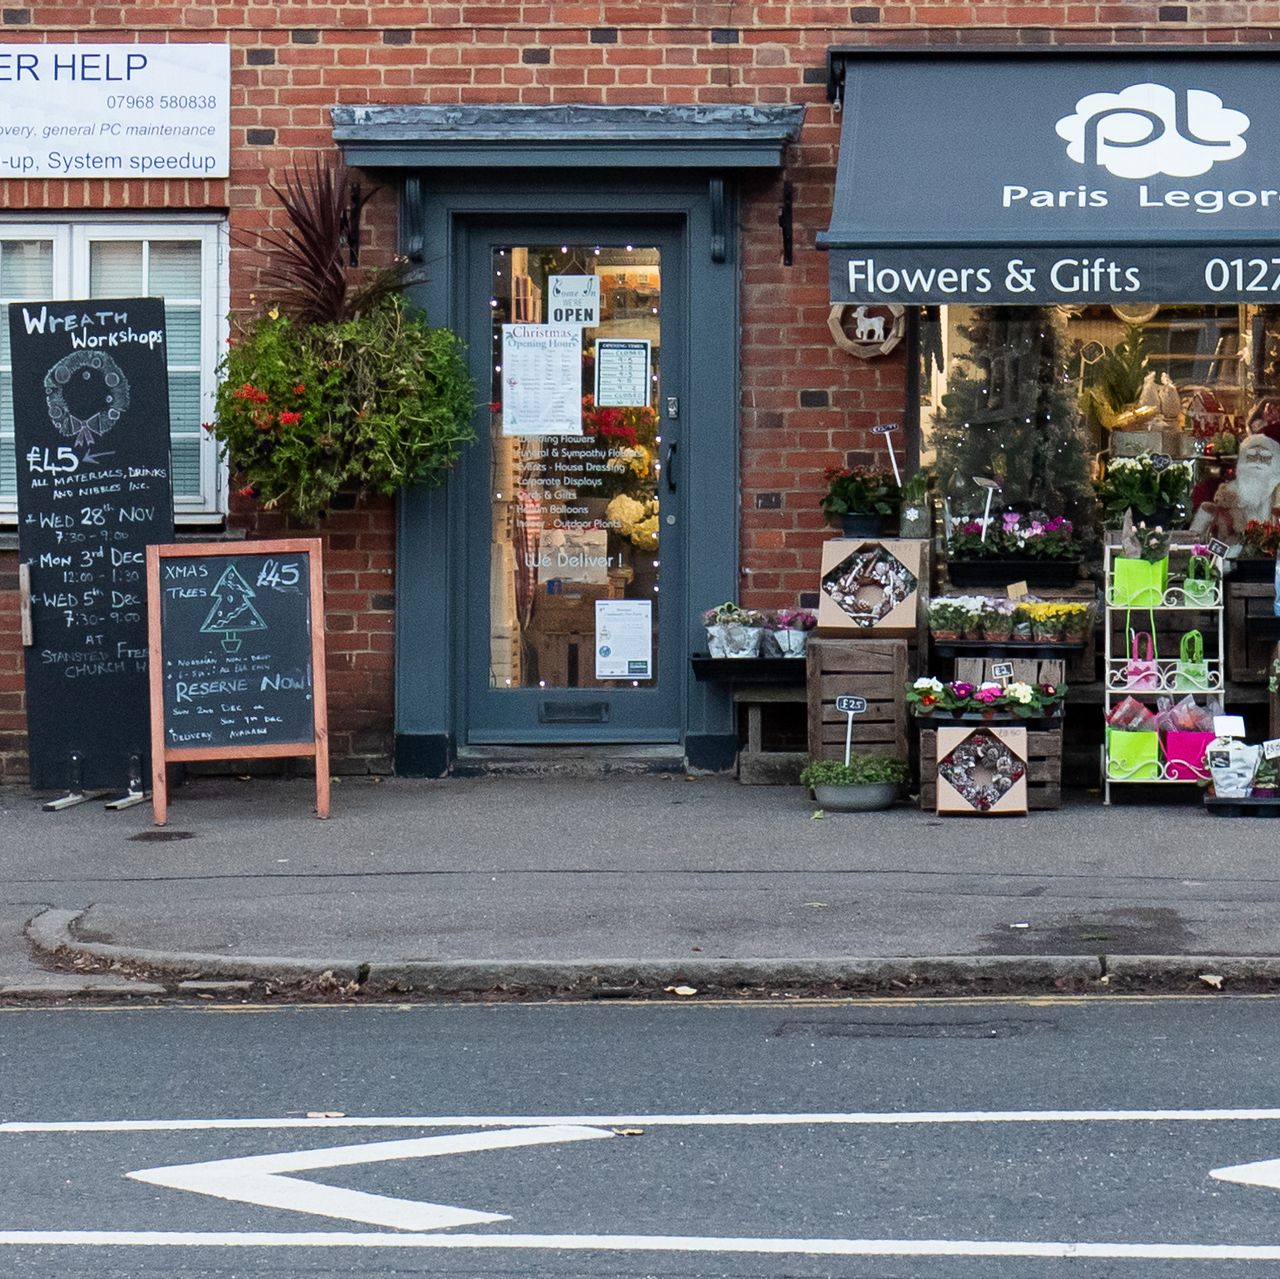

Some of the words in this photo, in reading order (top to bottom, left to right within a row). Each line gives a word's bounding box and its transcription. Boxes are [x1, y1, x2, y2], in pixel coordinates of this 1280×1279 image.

[54, 53, 148, 81] HELP
[106, 95, 154, 109] 07968
[160, 95, 217, 109] 580838
[42, 123, 96, 138] general
[99, 122, 122, 136] PC
[125, 123, 216, 136] maintenance
[47, 152, 122, 174] System
[129, 152, 216, 174] speedup
[1002, 185, 1108, 208] Paris
[848, 258, 992, 293] Flowers
[1004, 259, 1037, 293] &
[1051, 257, 1141, 293] Gifts
[554, 308, 594, 322] OPEN
[512, 326, 572, 338] Christmas
[508, 340, 547, 351] Opening
[549, 340, 577, 348] Hours
[561, 435, 595, 443] Flowers
[552, 449, 559, 457] &
[561, 448, 606, 458] Sympathy
[26, 446, 80, 476] £45
[555, 463, 584, 472] House
[586, 463, 626, 474] Dressing
[564, 477, 602, 487] Displays
[554, 491, 577, 499] Gifts
[550, 505, 589, 513] Balloons
[40, 512, 74, 528] WED
[120, 507, 156, 522] NOV
[554, 520, 591, 529] Outdoor
[524, 553, 552, 567] We
[557, 552, 613, 567] Deliver
[165, 565, 208, 580] XMAS
[256, 559, 300, 588] £45
[43, 593, 78, 607] WED
[167, 587, 207, 600] TREES
[85, 635, 104, 645] AT
[65, 660, 126, 678] CHURCH
[176, 679, 248, 702] RESERVE
[842, 698, 863, 710] £25
[172, 731, 213, 742] DELIVERY
